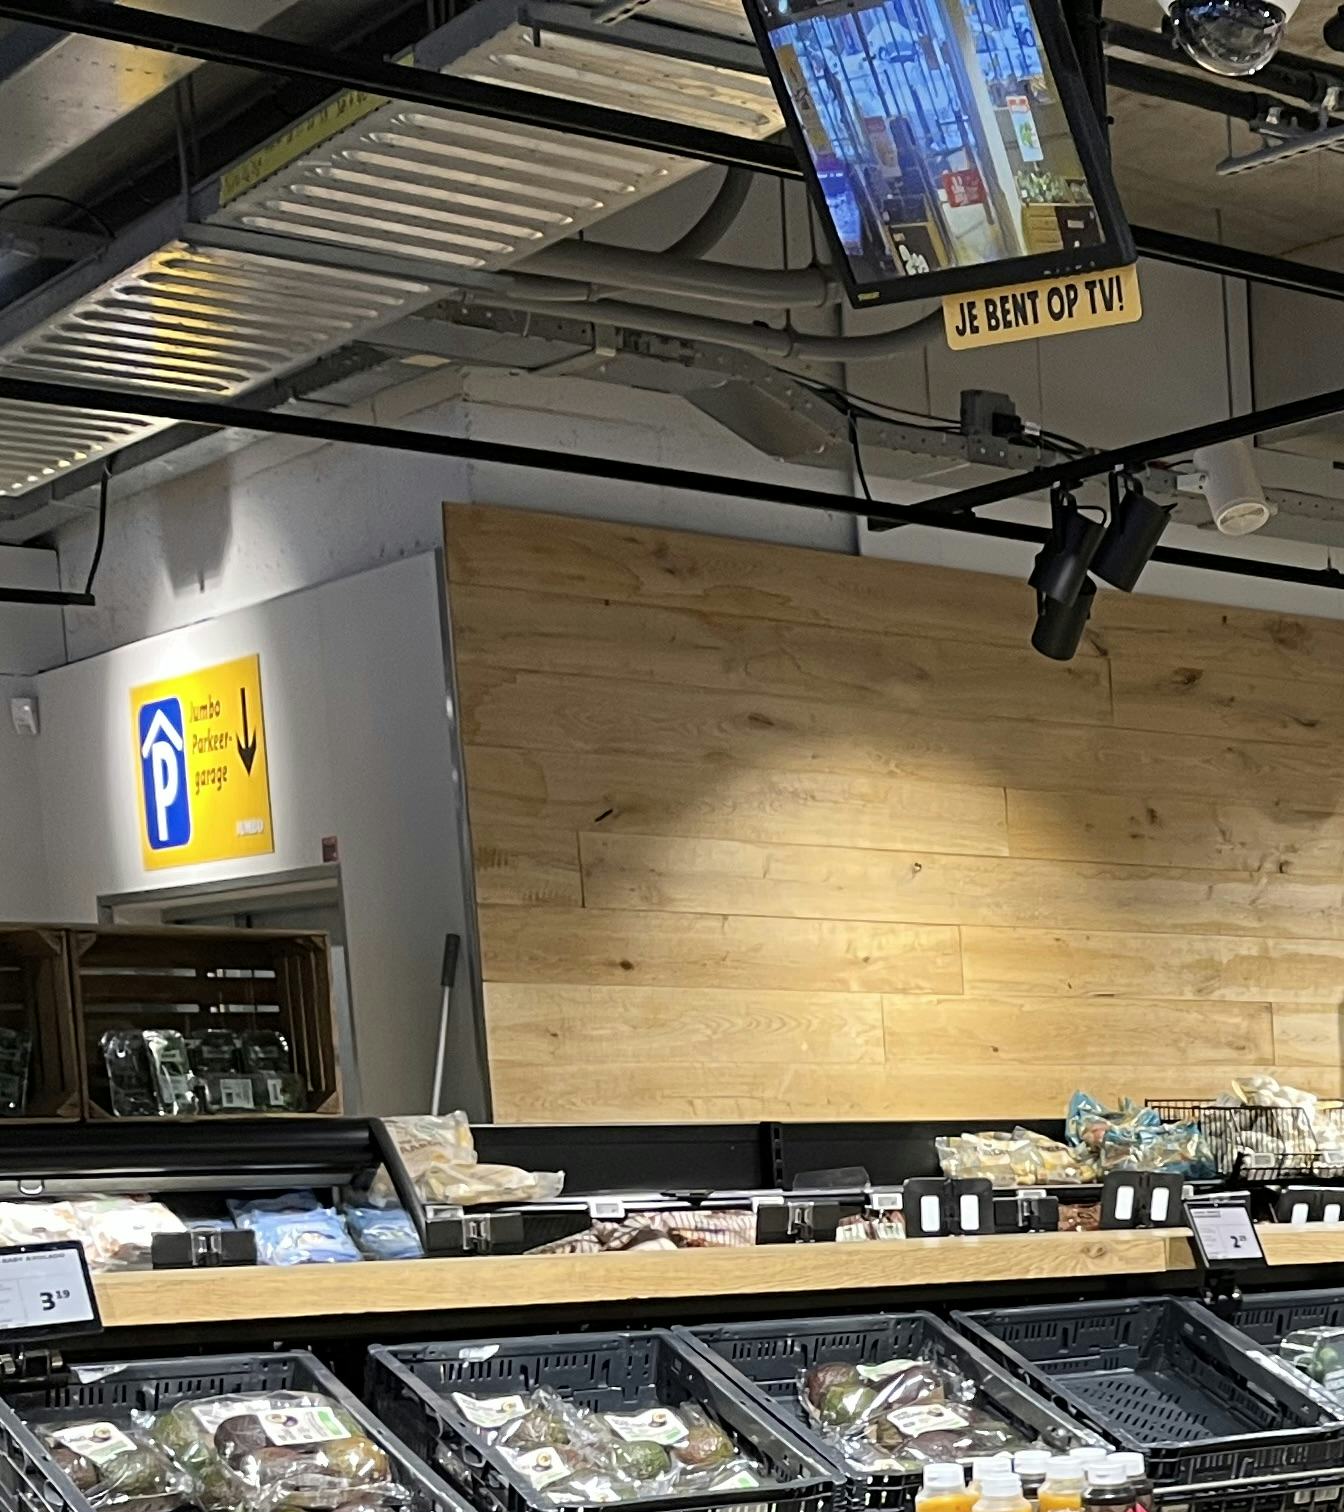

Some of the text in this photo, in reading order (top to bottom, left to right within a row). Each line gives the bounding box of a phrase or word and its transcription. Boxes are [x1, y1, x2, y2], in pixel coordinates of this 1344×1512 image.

[956, 275, 1124, 337] JE BENT OP TV!
[192, 729, 232, 754] Parkeer-
[152, 740, 179, 842] P
[195, 765, 228, 795] garage
